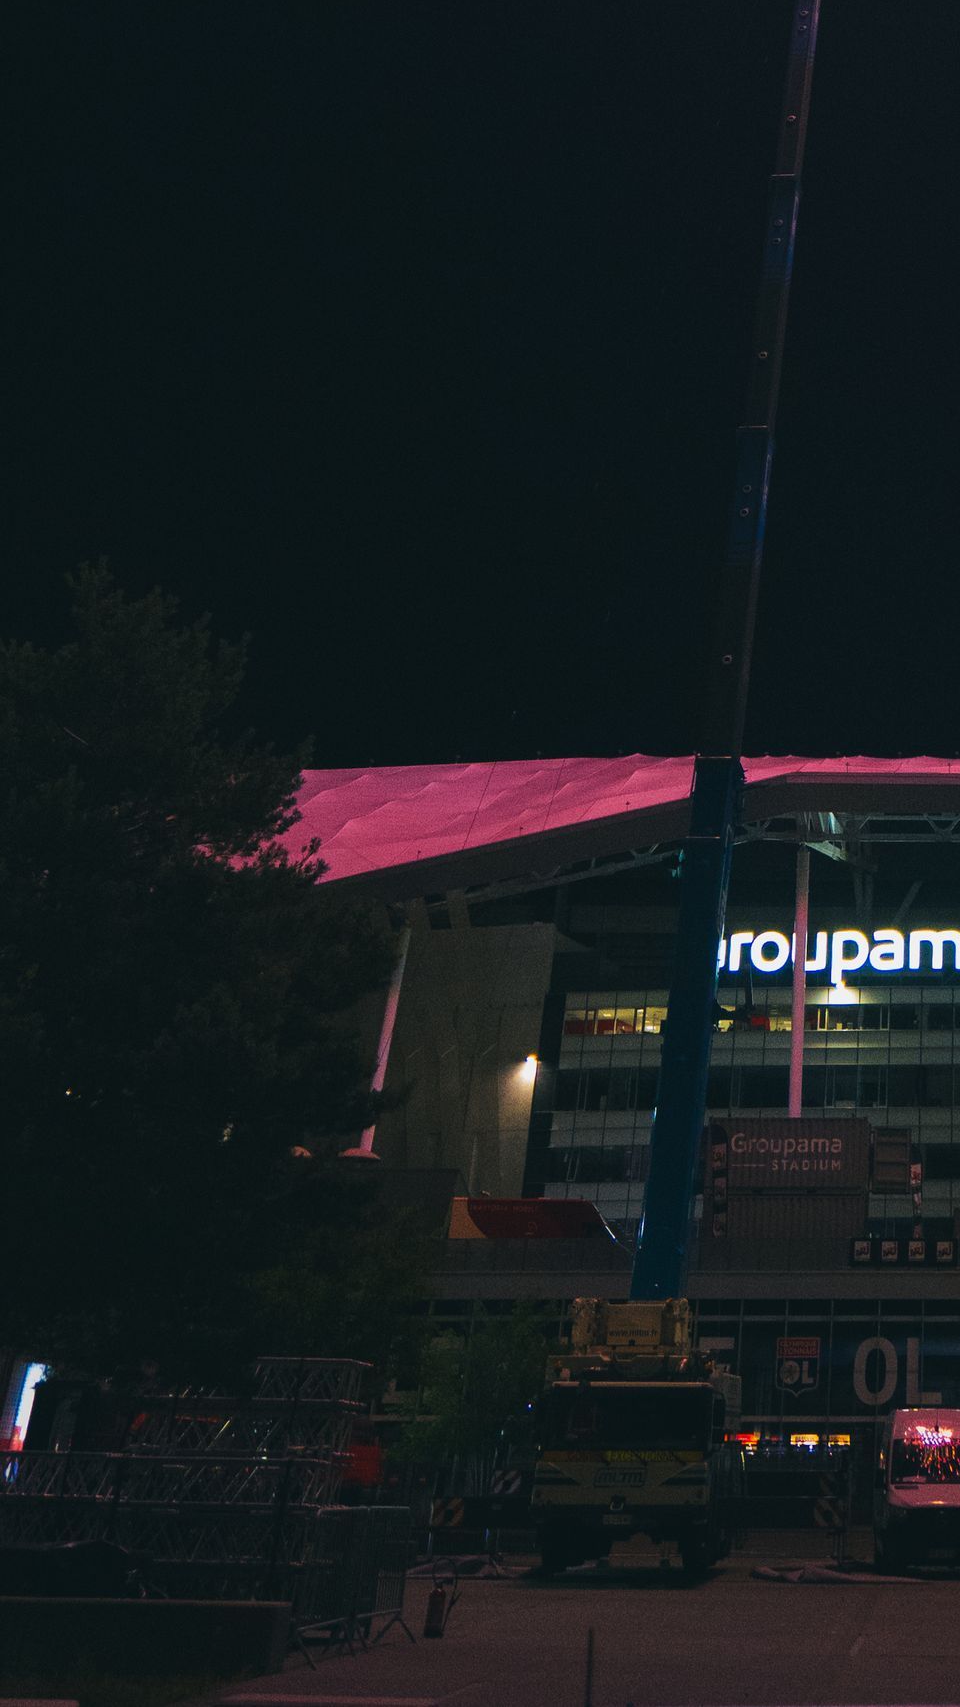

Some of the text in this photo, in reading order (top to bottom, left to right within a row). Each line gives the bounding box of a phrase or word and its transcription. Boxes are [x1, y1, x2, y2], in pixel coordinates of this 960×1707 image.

[730, 1132, 843, 1156] Groupama
[771, 1160, 842, 1172] STADIUM
[779, 1360, 814, 1385] OL
[853, 1336, 942, 1406] OL
